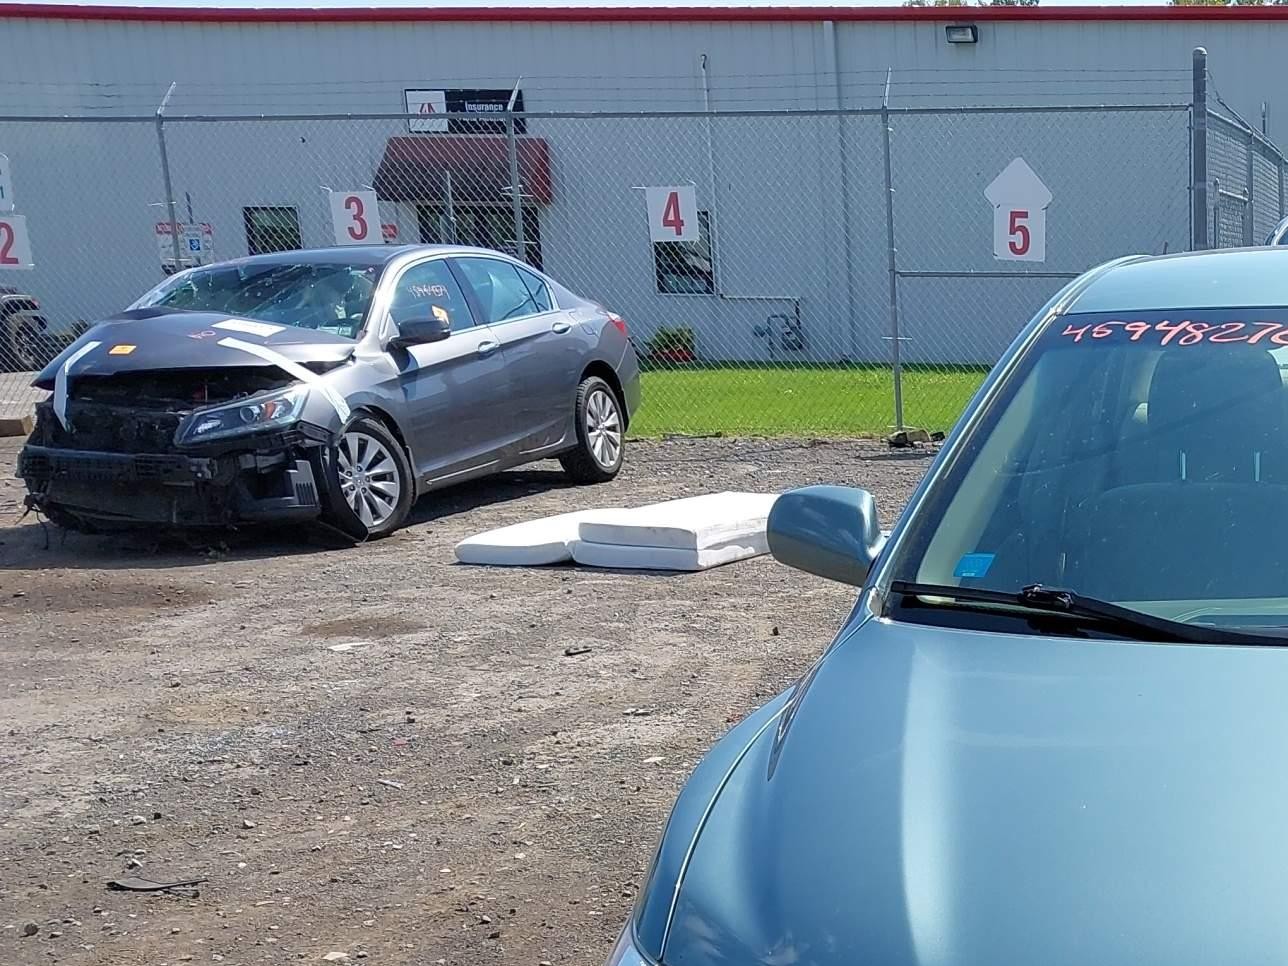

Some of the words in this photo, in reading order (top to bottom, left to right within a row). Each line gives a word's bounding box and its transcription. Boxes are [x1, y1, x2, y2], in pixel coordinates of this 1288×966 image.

[464, 101, 504, 112] Insurance
[344, 196, 368, 241] 3
[662, 192, 685, 236] 4
[1008, 211, 1031, 256] 5
[0, 222, 19, 265] 2
